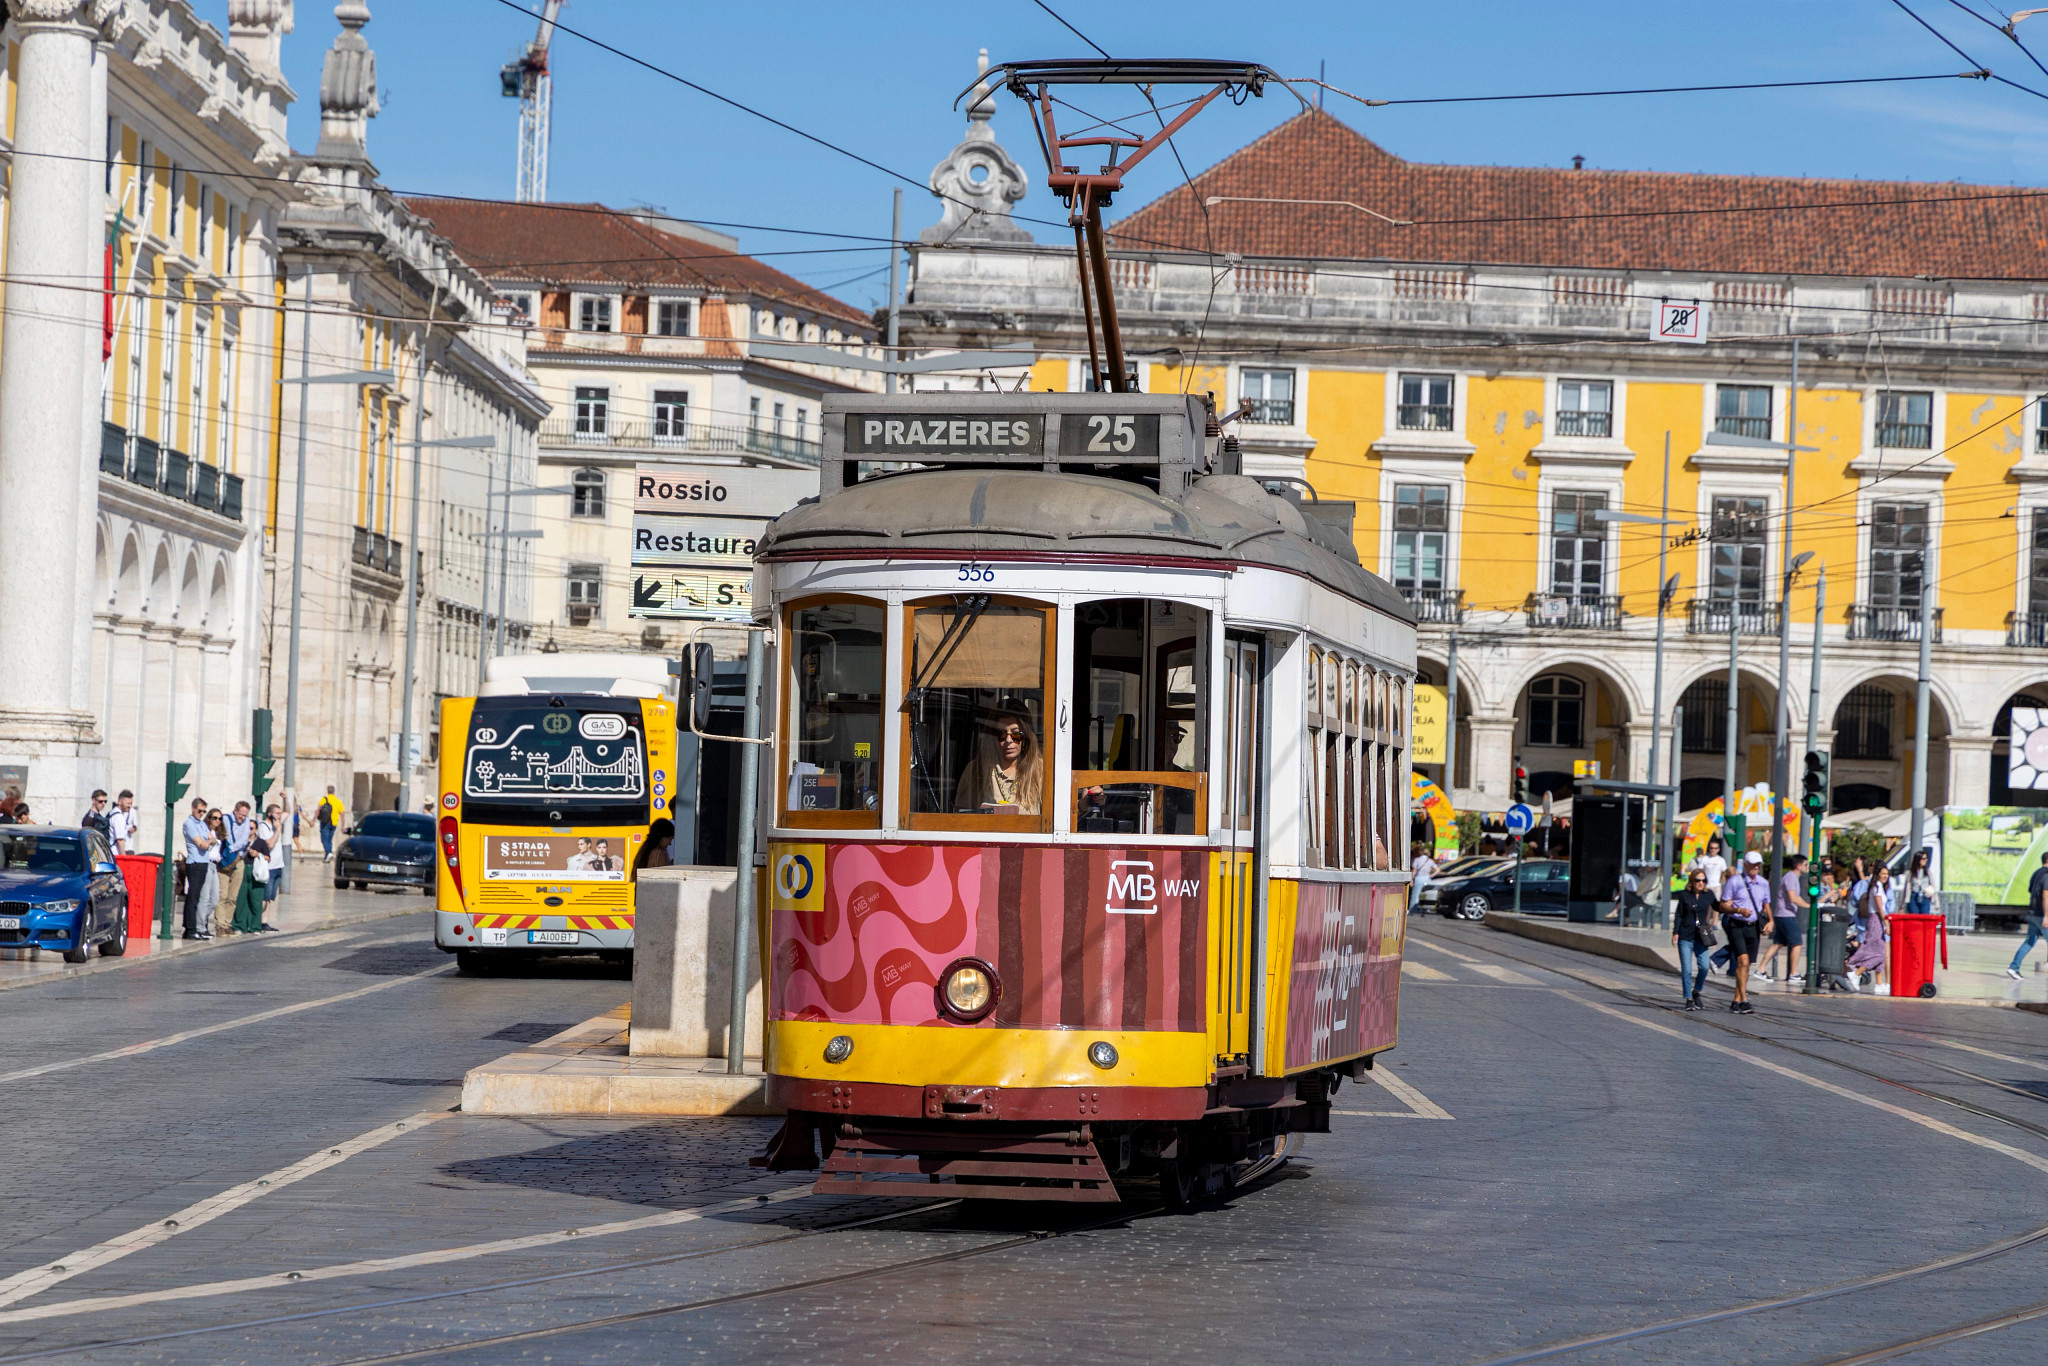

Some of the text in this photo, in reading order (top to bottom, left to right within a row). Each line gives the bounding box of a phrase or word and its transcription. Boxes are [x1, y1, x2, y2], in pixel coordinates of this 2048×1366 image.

[864, 420, 1030, 445] PRAZERES
[1087, 415, 1136, 452] 25
[638, 476, 727, 501] Rossio
[635, 528, 757, 555] Restaura
[958, 564, 994, 582] 556
[648, 708, 669, 716] 2781
[591, 719, 614, 729] GÁS
[1413, 715, 1435, 725] EJA
[803, 778, 817, 787] 25E
[803, 795, 816, 807] 02
[511, 842, 551, 850] STRADA
[1106, 873, 1200, 901] MB WAY
[867, 892, 881, 903] WAY
[493, 932, 506, 941] TP
[898, 961, 912, 973] WAY
